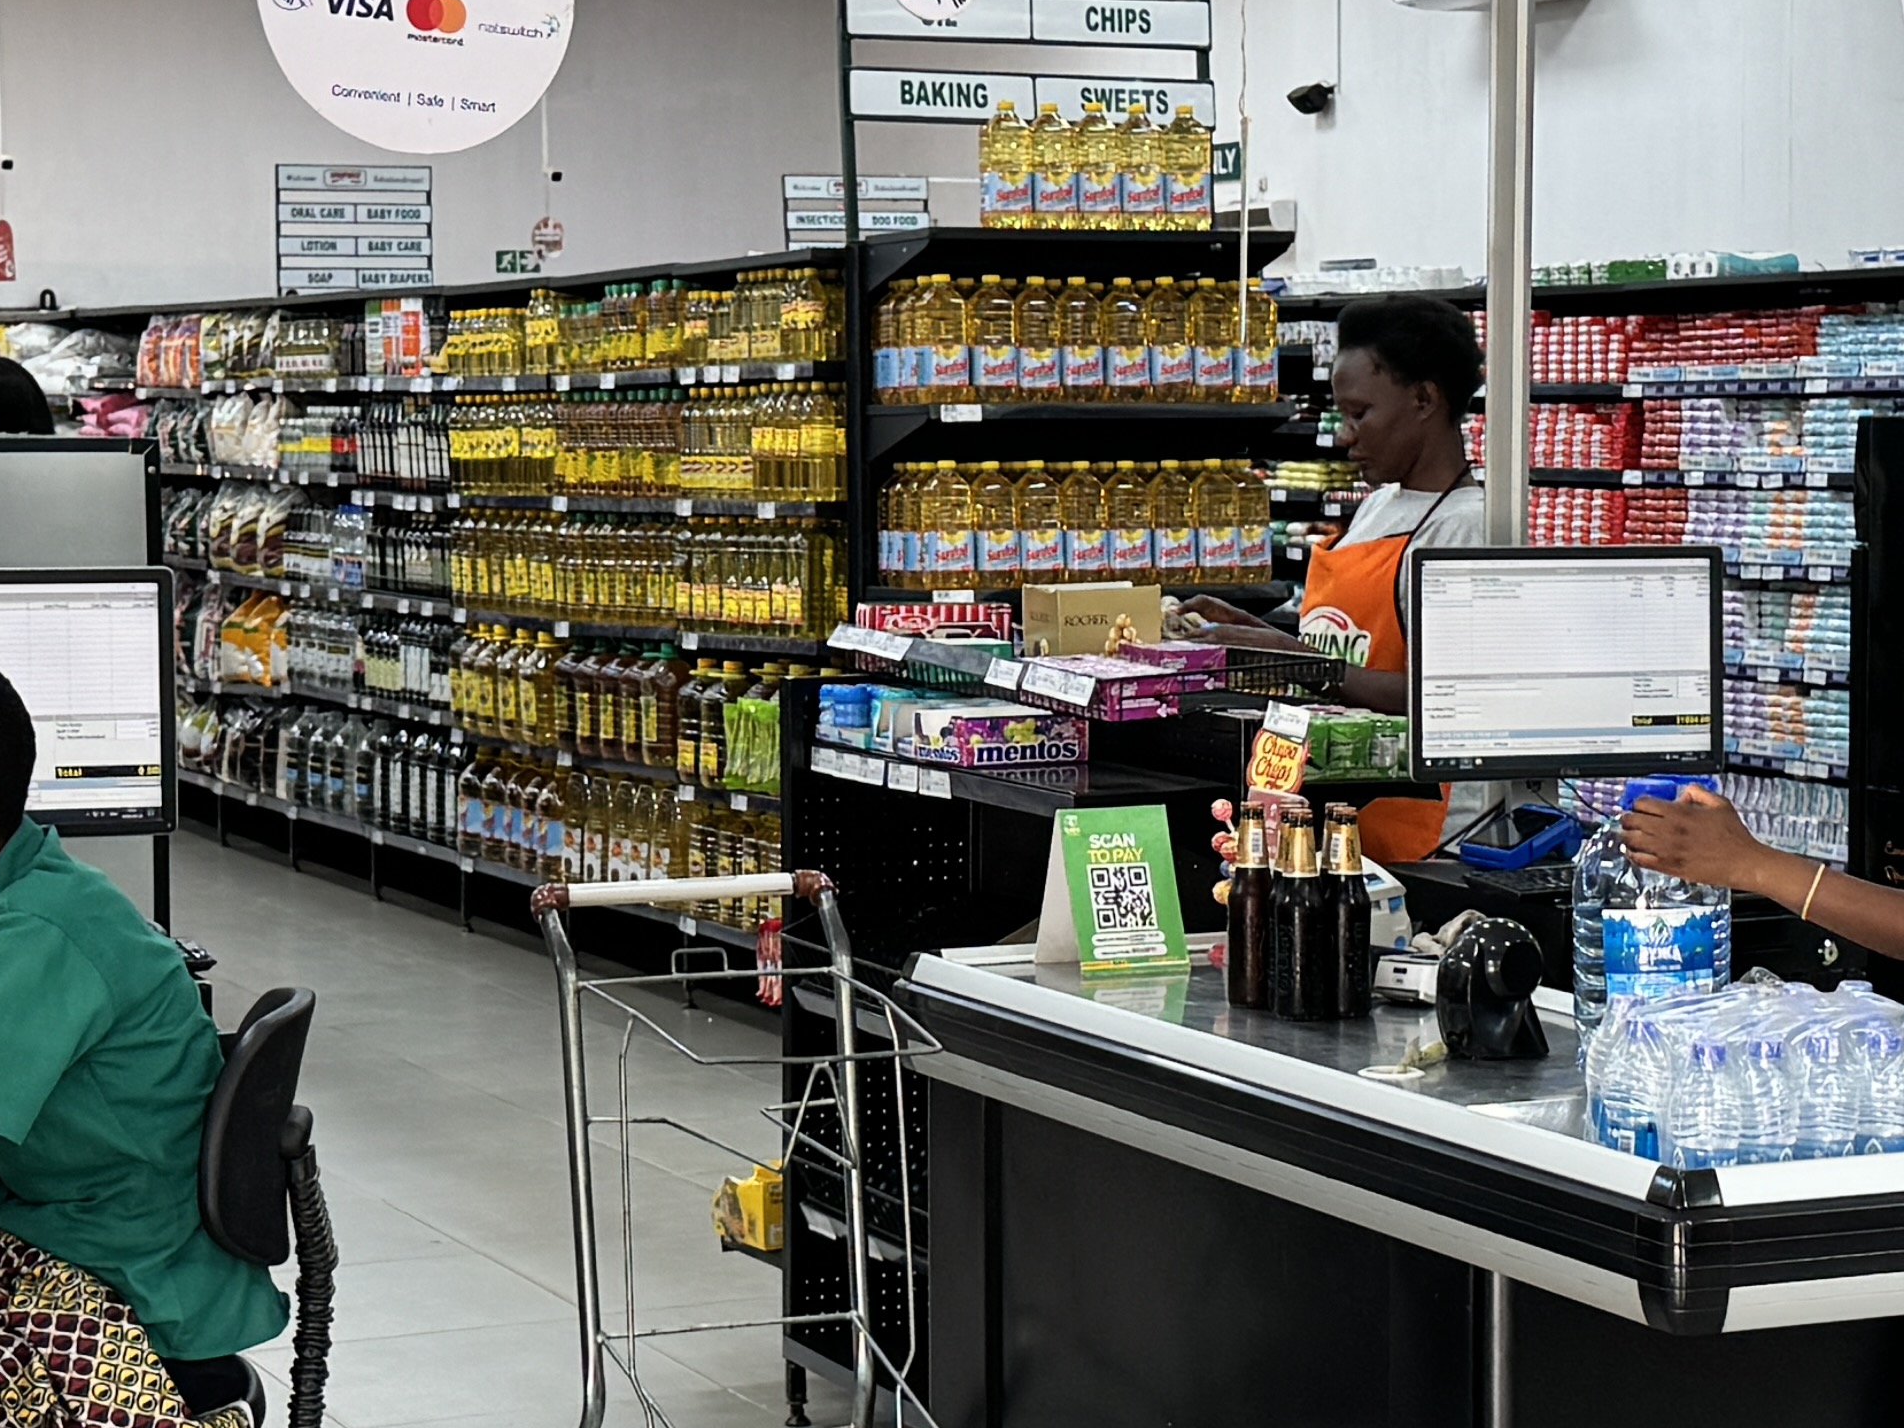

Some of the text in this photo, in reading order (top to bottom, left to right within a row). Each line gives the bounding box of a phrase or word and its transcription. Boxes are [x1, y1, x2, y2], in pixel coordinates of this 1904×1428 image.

[1086, 6, 1151, 34] CHIPS
[408, 33, 464, 46] mastercard
[332, 84, 496, 112] Convenient Safe Smart
[900, 79, 988, 109] BAKING
[1081, 87, 1168, 114] SWEETS
[291, 208, 345, 218] ORAL CARE
[367, 208, 421, 219] BABY FOOD
[872, 216, 918, 225] DOG FOOD
[301, 241, 337, 251] LOTION
[368, 241, 422, 252] BABY CARE
[308, 273, 333, 283] SOAP
[362, 273, 430, 283] BABY DIAPERS
[1064, 614, 1109, 627] ROCHER
[975, 740, 1079, 763] mentos
[1262, 736, 1298, 760] Chupa
[1255, 756, 1293, 782] Chups
[1089, 833, 1135, 849] SCAN
[1087, 847, 1143, 863] TO PAY
